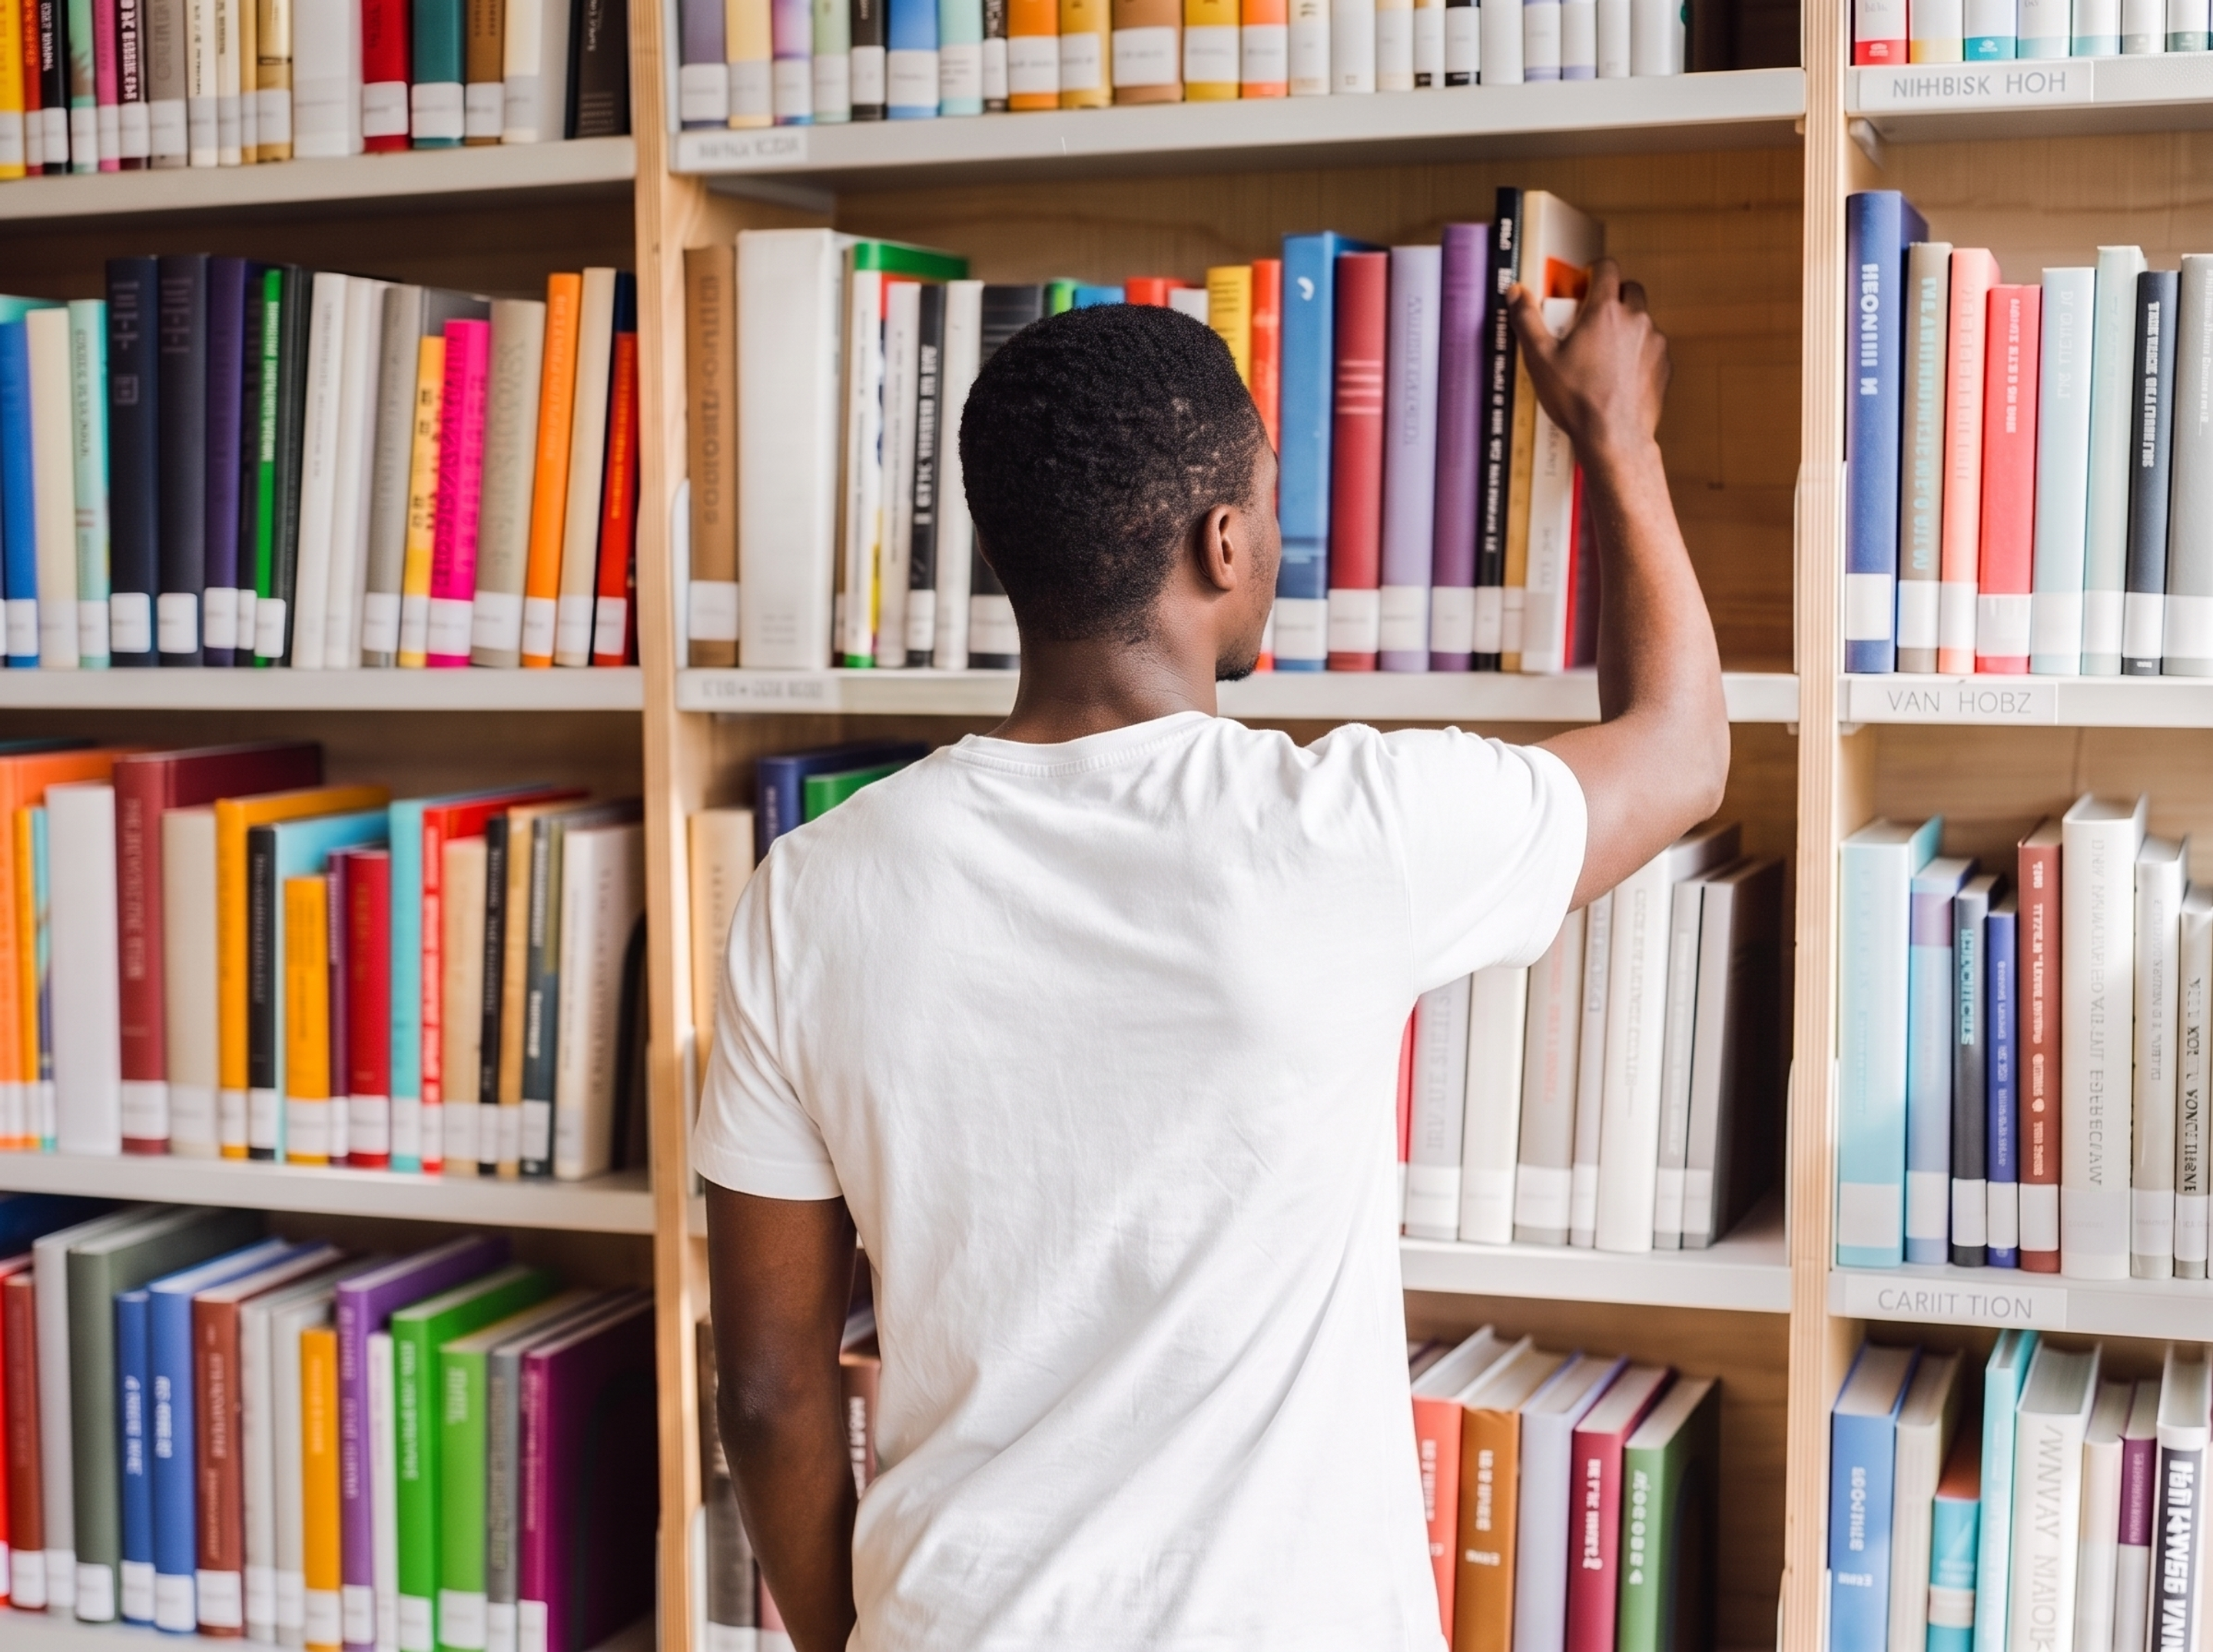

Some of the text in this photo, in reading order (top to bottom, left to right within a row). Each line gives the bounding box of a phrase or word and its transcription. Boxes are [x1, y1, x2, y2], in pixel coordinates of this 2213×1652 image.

[2006, 71, 2066, 94] HOH
[1886, 690, 2032, 715] VAN HOBZ
[1966, 1294, 2032, 1319] TION
